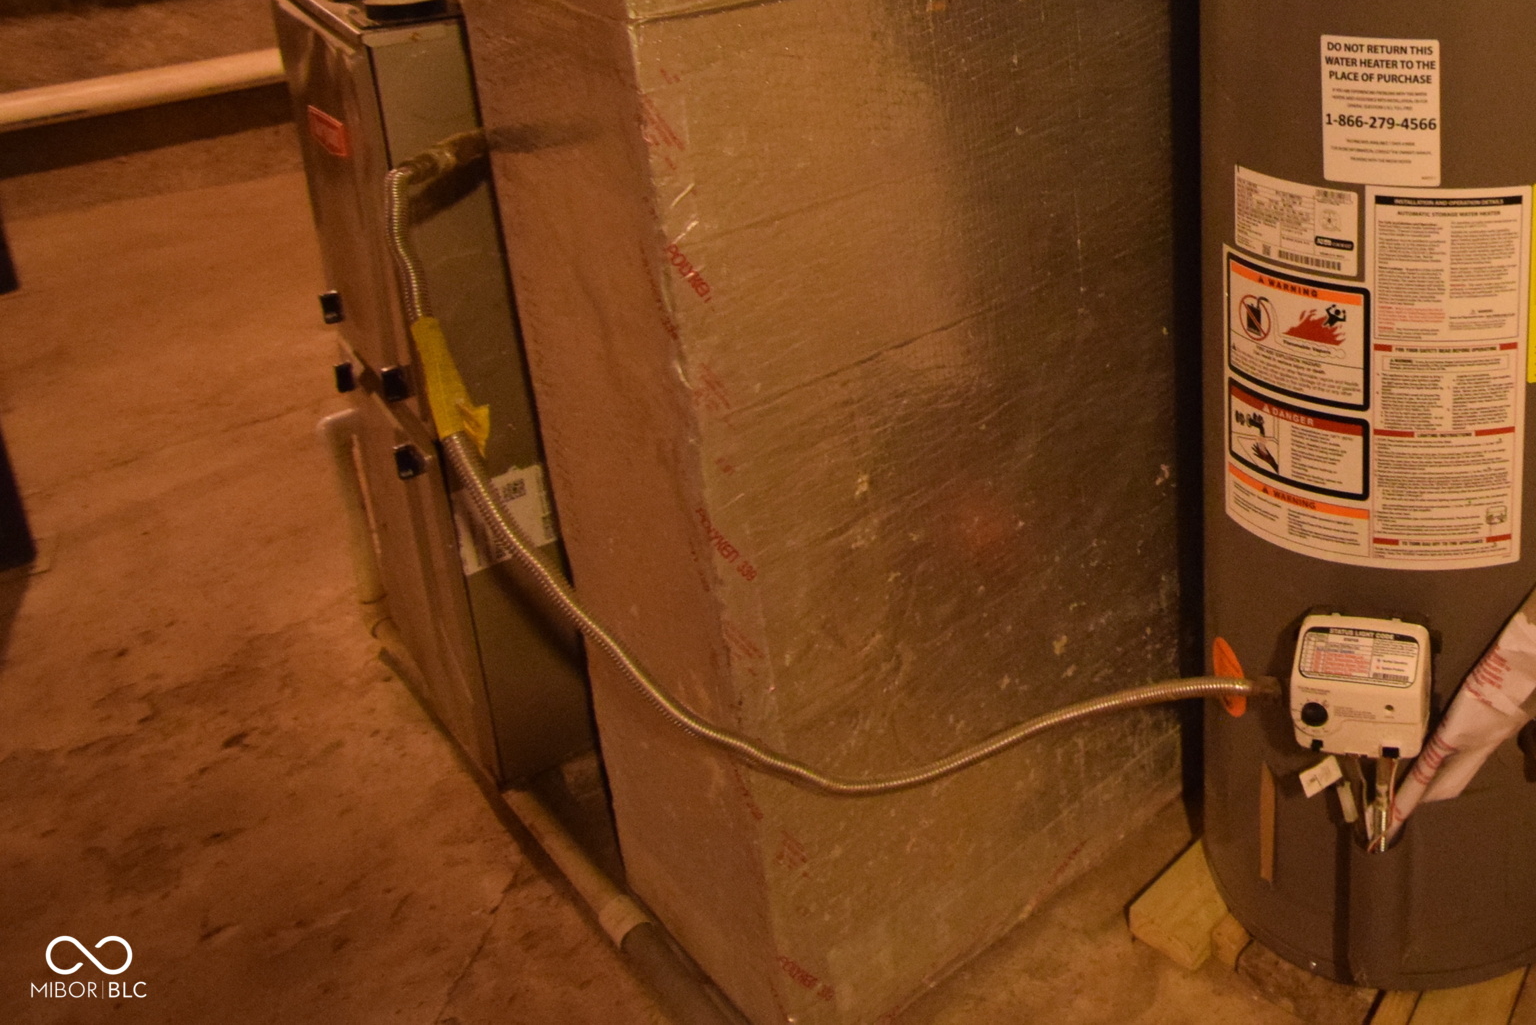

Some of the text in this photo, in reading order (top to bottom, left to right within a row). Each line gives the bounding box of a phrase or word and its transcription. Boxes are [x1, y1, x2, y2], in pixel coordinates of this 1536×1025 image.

[1327, 42, 1433, 55] DO NOT RETURN THIS
[1325, 56, 1436, 70] WATER HEATER TO THE
[1329, 71, 1432, 84] PLACE OF PURCHASE
[1325, 113, 1437, 131] 1-866-279-4566
[1267, 278, 1319, 298] WARNING
[1272, 407, 1315, 426] DANGER
[1273, 488, 1317, 510] WARNING
